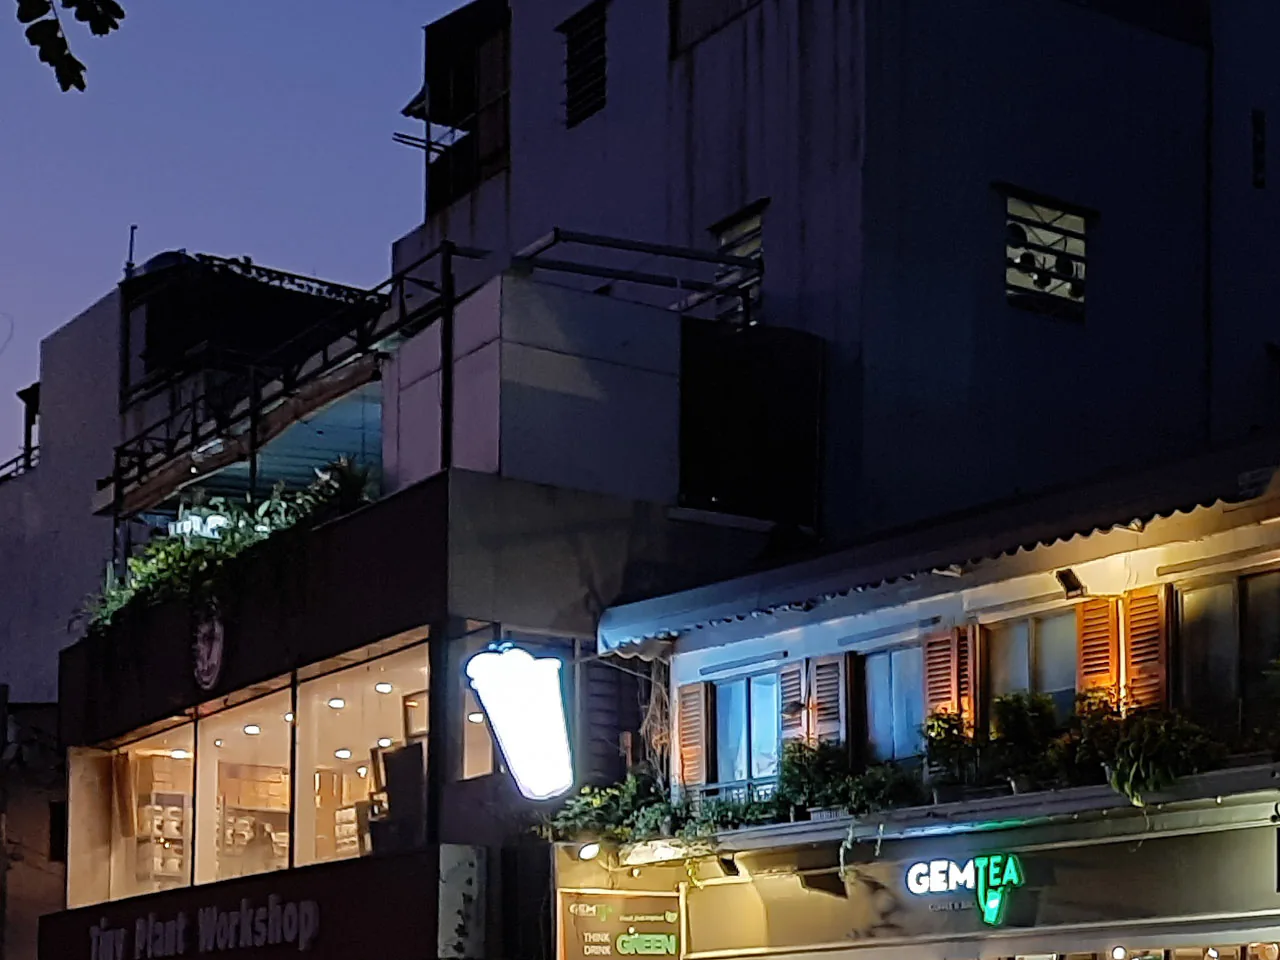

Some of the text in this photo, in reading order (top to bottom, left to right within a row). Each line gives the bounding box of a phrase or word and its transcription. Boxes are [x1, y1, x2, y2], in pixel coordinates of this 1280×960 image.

[134, 912, 187, 960] Plant
[199, 894, 320, 951] Workshop
[616, 933, 677, 955] GREEN
